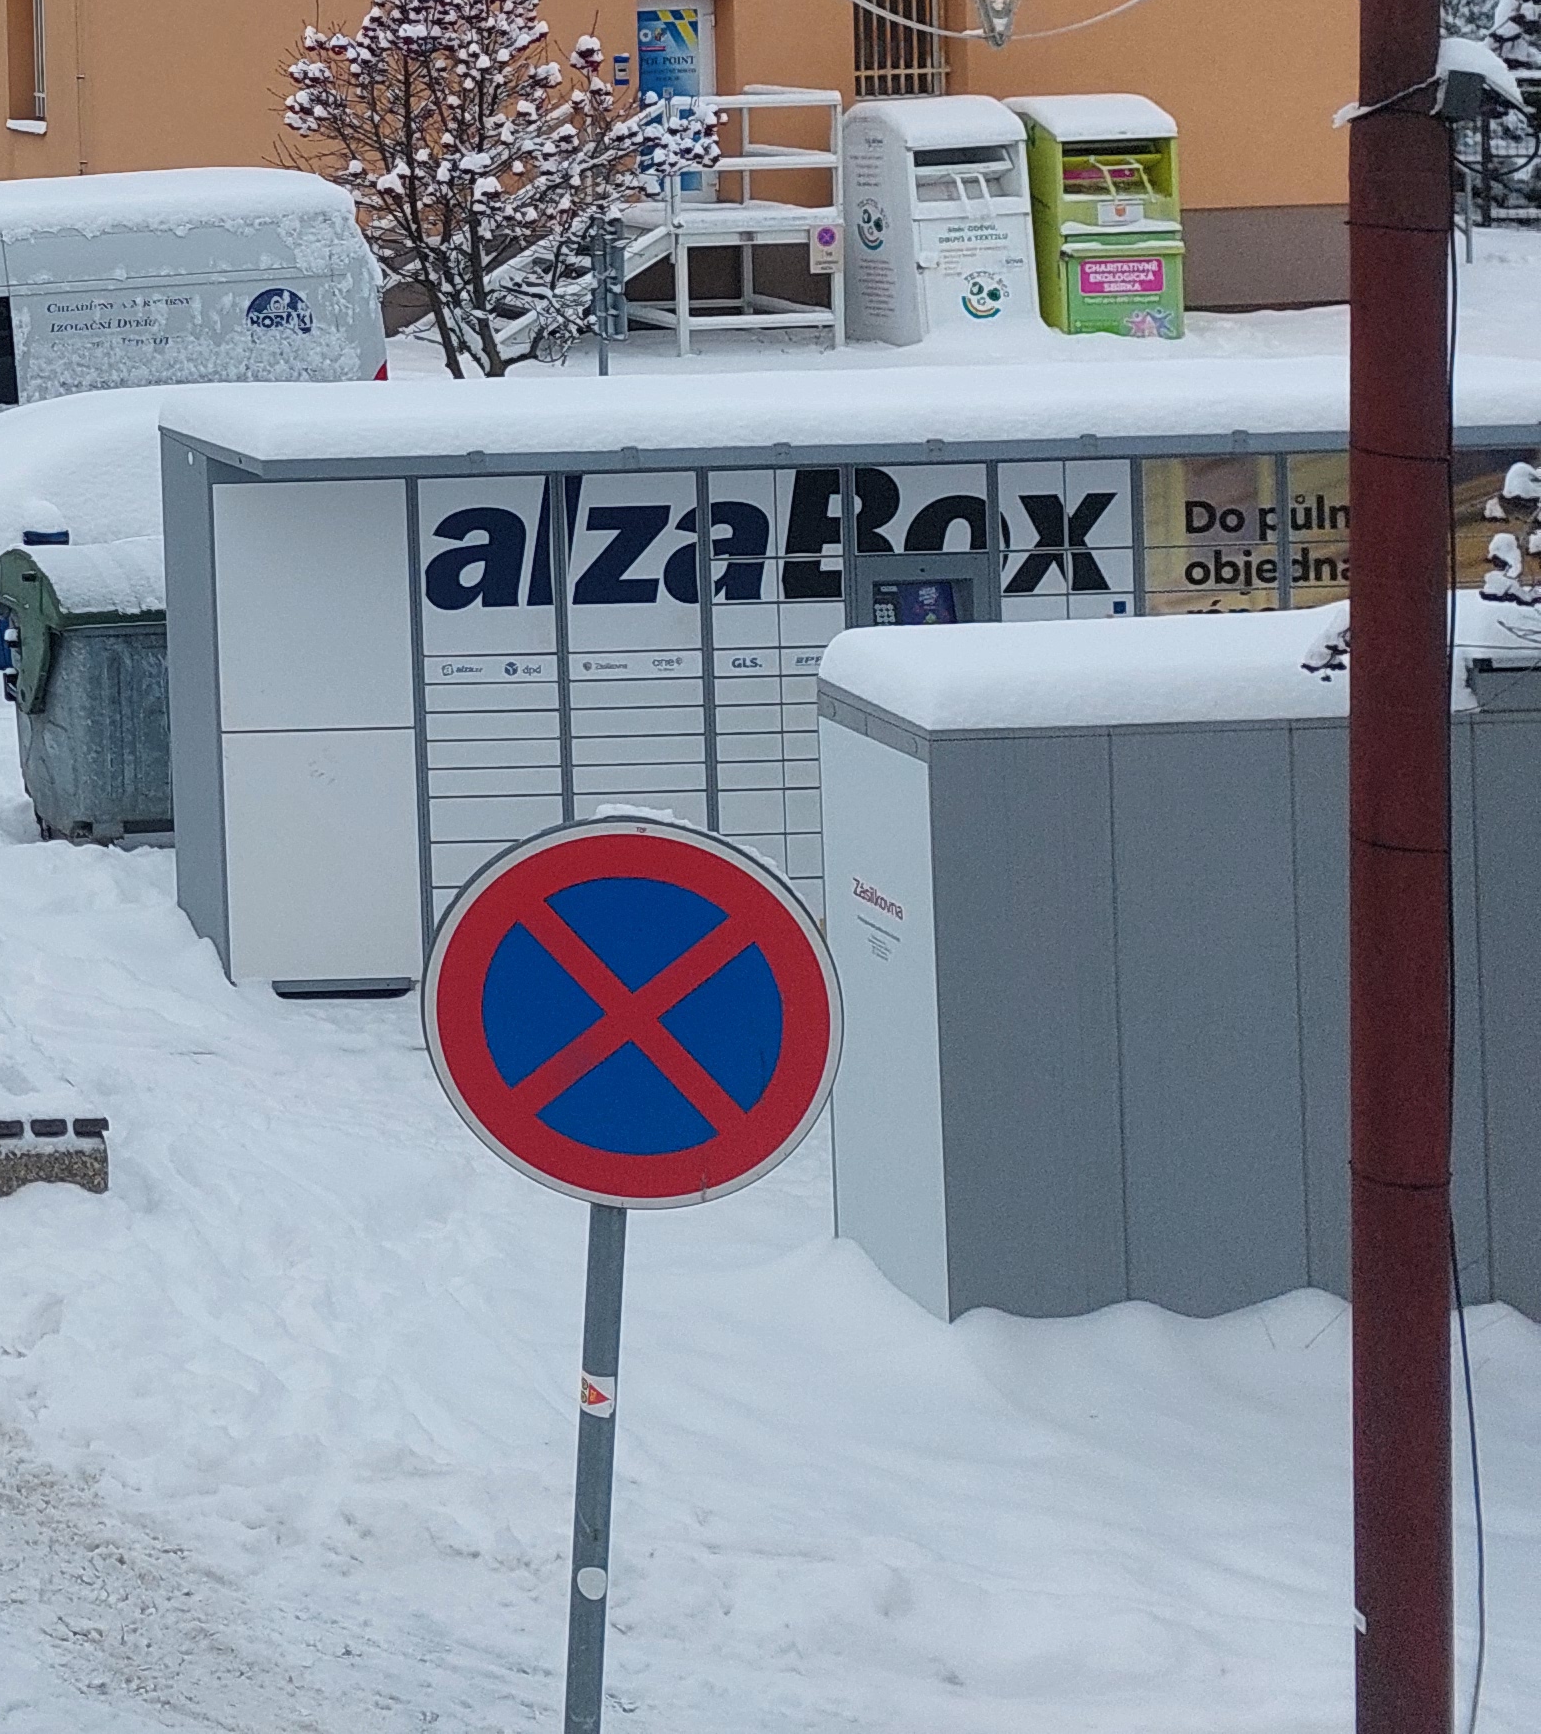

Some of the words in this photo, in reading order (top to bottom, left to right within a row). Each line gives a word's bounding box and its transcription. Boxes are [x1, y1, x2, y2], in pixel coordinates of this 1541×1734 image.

[663, 55, 694, 65] POINT
[49, 317, 113, 334] IZOLAČNÍ
[1184, 500, 1245, 535] Do
[1258, 493, 1351, 541] půln
[424, 467, 1118, 612] alzaBox
[522, 664, 542, 676] dpd
[852, 877, 903, 921] Zásilkovna
